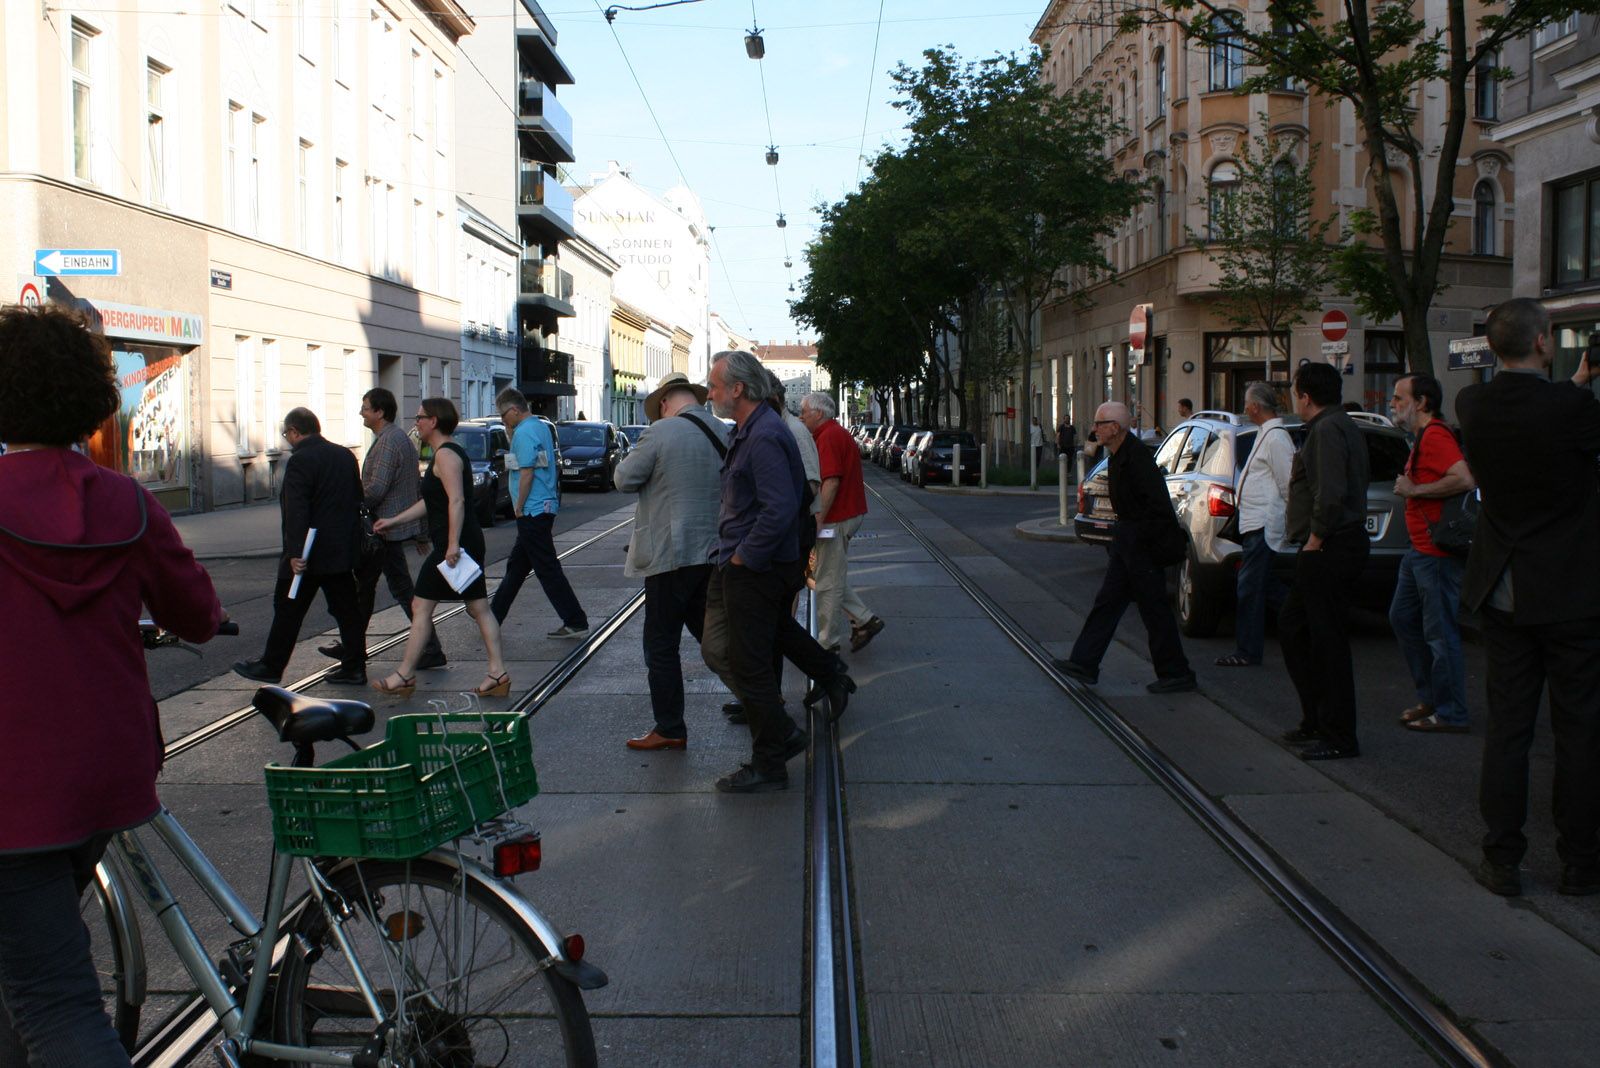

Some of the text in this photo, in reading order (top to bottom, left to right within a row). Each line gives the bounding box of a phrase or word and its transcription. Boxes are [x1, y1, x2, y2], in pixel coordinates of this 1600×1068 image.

[578, 208, 655, 224] SUN STAR
[612, 239, 672, 249] SONNEN
[63, 256, 110, 268] EINBAHN
[618, 254, 672, 264] STUDIO
